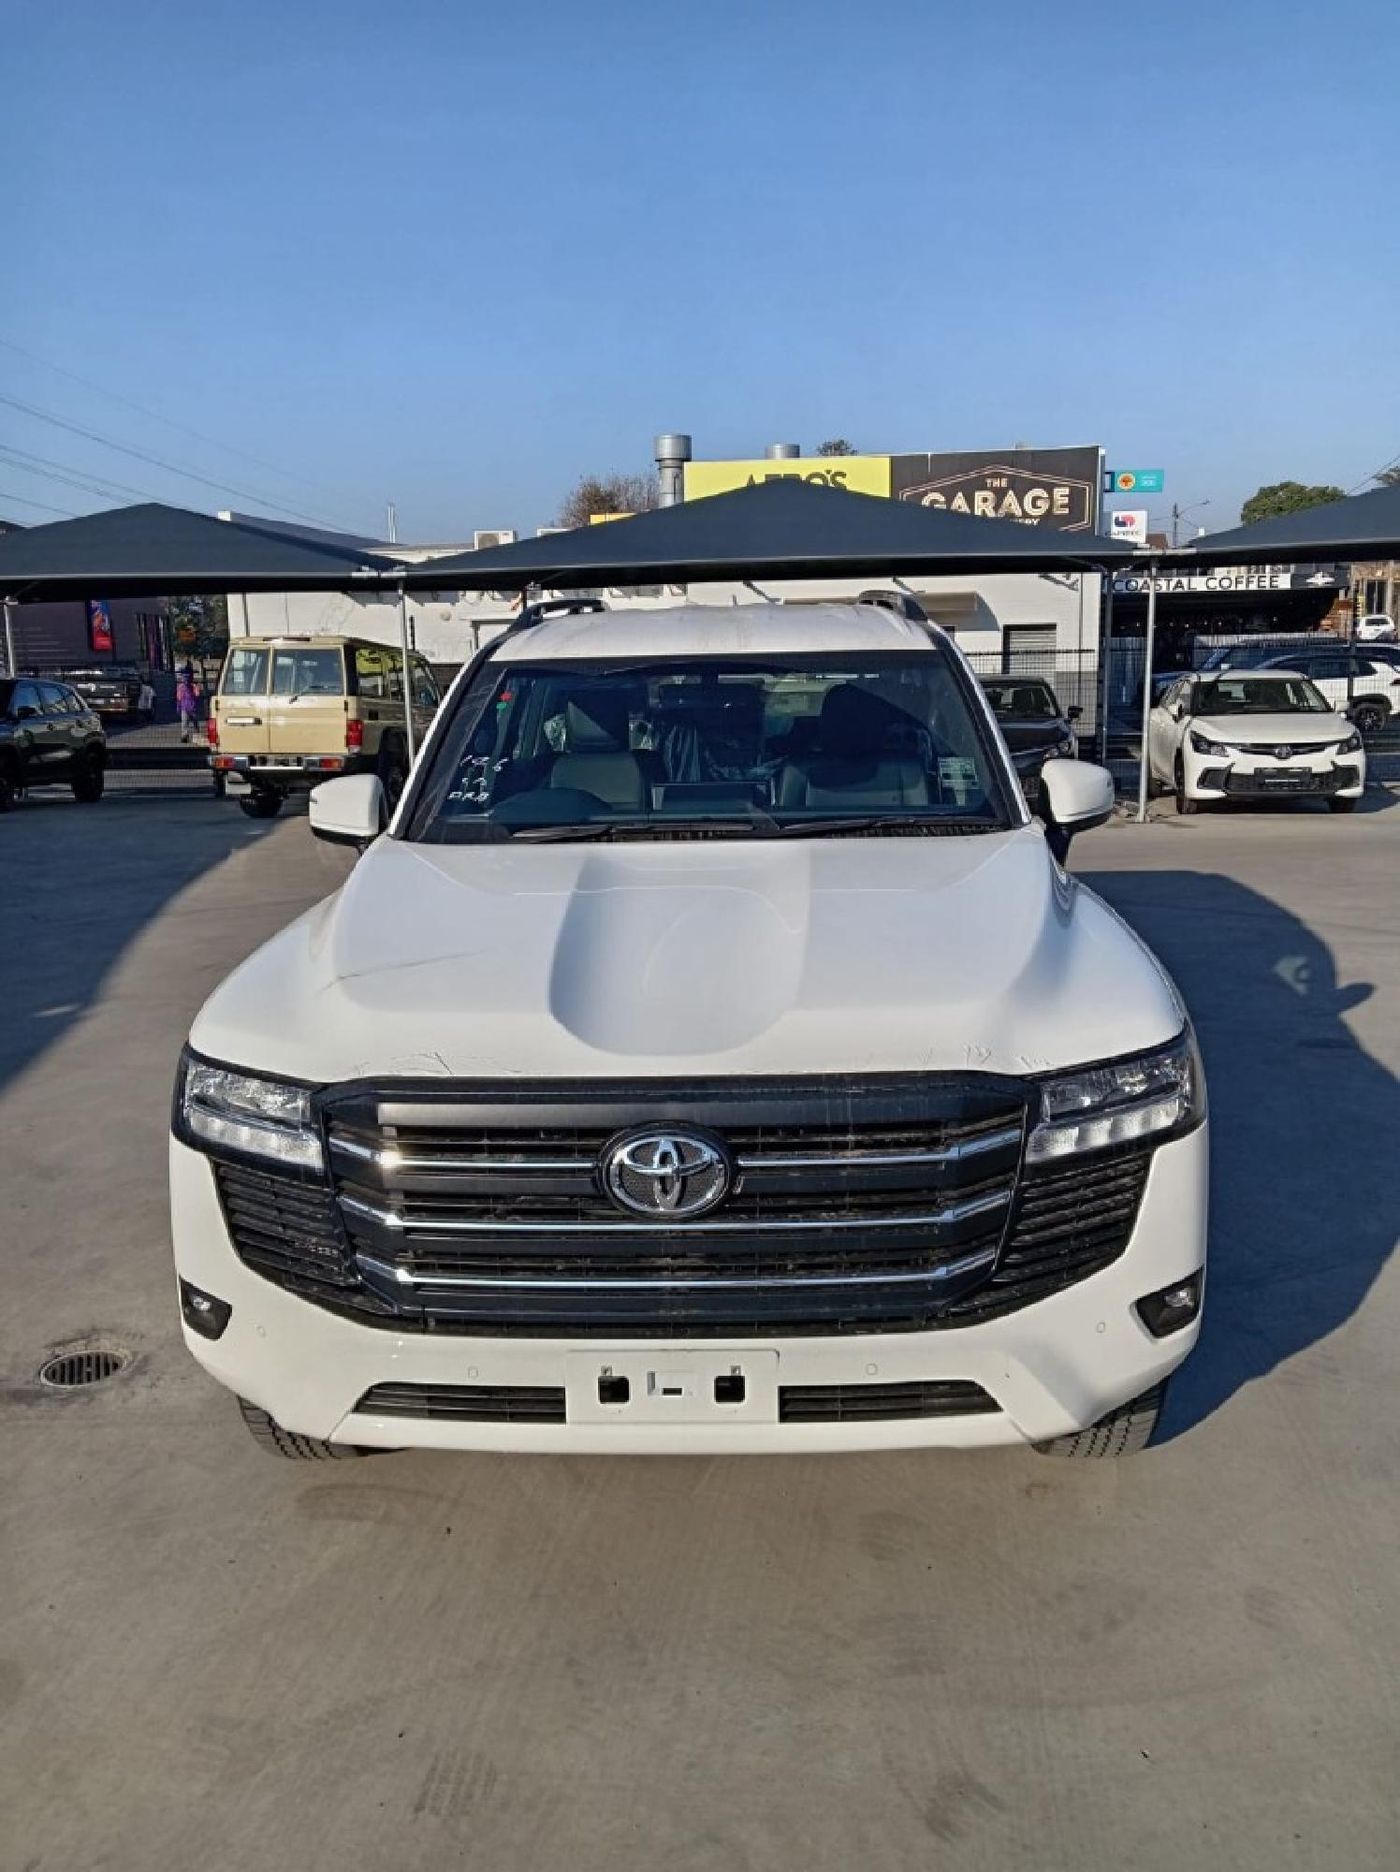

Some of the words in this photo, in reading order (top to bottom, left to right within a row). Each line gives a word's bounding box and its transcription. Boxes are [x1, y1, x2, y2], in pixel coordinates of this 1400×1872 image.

[985, 477, 1008, 488] THE
[921, 487, 1070, 518] GARAGE
[1113, 576, 1197, 592] COASTAL
[1206, 575, 1280, 590] COFFEE
